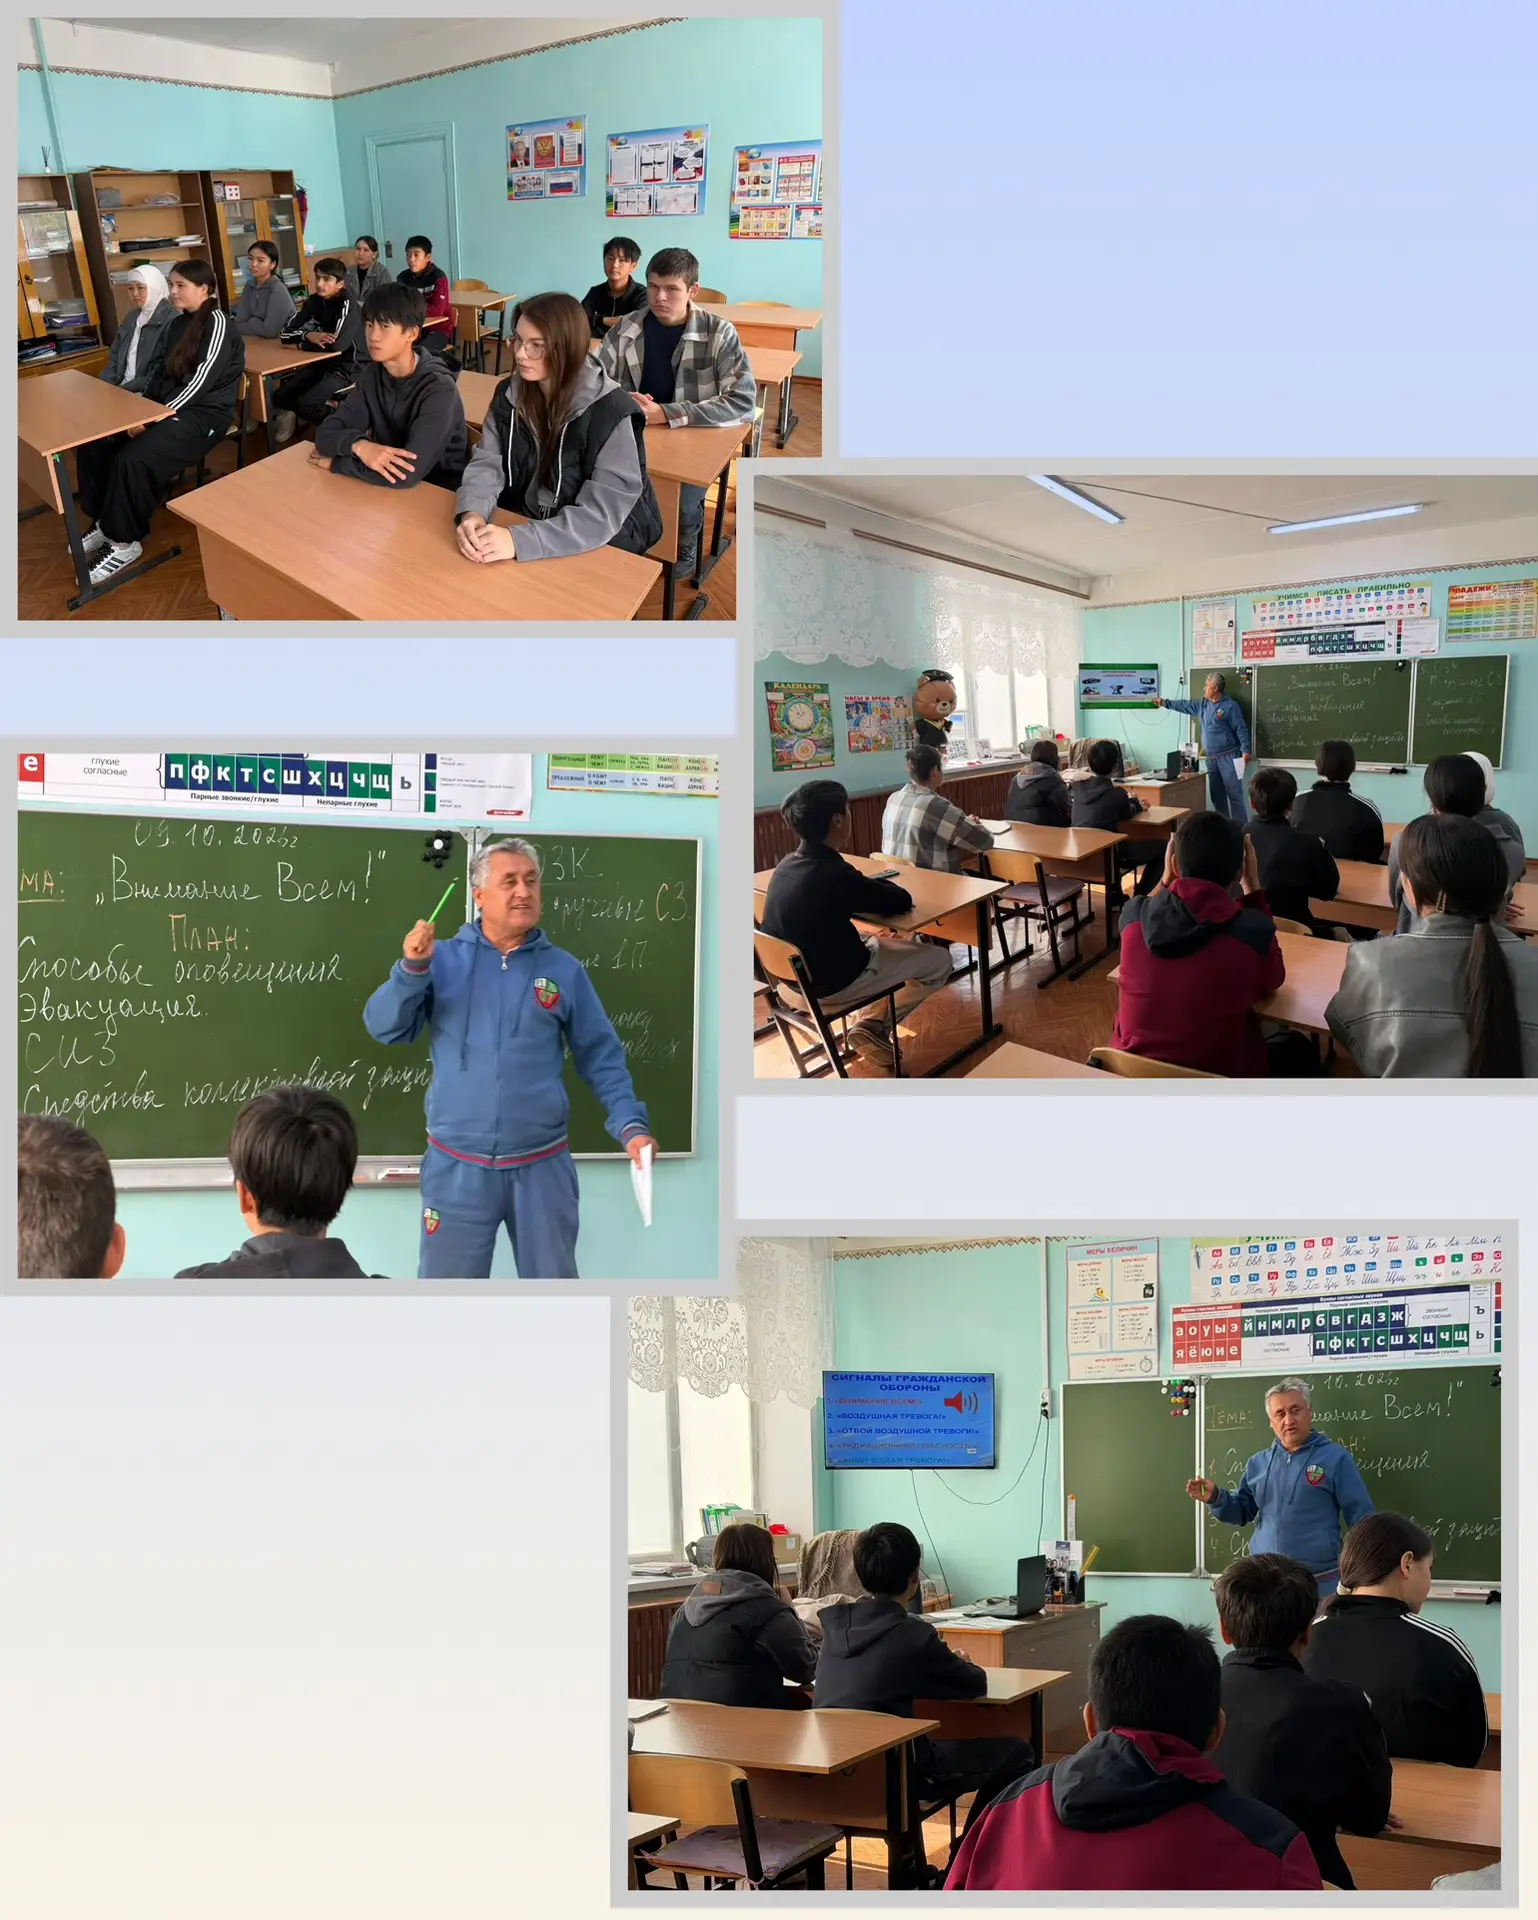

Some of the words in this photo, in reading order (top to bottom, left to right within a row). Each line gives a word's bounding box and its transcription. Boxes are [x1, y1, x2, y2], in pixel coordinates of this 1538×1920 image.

[1277, 592, 1309, 600] УЧИМСЯ
[1317, 588, 1350, 597] ПИСАТЬ
[1357, 582, 1411, 593] ПРАВИЛЬНО
[1455, 585, 1492, 594] ПАДЕЖИ
[773, 682, 821, 690] КАЛЕНДАРЬ
[24, 756, 38, 772] е
[91, 757, 120, 767] глухие
[83, 767, 128, 777] согласные
[170, 765, 184, 779] п
[191, 760, 210, 785] ф
[217, 766, 231, 782] к
[240, 767, 252, 782] т
[263, 768, 275, 783] с
[283, 769, 301, 784] ш
[308, 770, 322, 785] х
[330, 772, 345, 789] ц
[353, 773, 365, 787] ч
[372, 774, 390, 792] щ
[190, 792, 219, 803] Парные
[221, 793, 279, 804] звонкие/глухие
[317, 798, 352, 808] Непарные
[354, 799, 379, 809] глухие
[25, 1031, 117, 1074] СИЗ
[1107, 1245, 1138, 1254] ВЕЛИЧИН
[1244, 1319, 1252, 1332] й
[1258, 1320, 1266, 1330] н
[1272, 1320, 1282, 1330] м
[1286, 1318, 1296, 1328] л
[1302, 1317, 1310, 1330] р
[1316, 1314, 1326, 1326] б
[1332, 1316, 1340, 1326] в
[1347, 1314, 1355, 1324] г
[1361, 1314, 1372, 1326] д
[1377, 1312, 1386, 1322] з
[1391, 1310, 1404, 1321] ж
[1176, 1326, 1184, 1336] а
[1188, 1326, 1197, 1335] о
[1202, 1325, 1210, 1337] у
[1215, 1324, 1226, 1334] ы
[1230, 1323, 1238, 1332] э
[1316, 1339, 1324, 1350] п
[1330, 1336, 1341, 1352] ф
[1346, 1337, 1355, 1347] к
[1362, 1336, 1370, 1346] т
[1376, 1335, 1385, 1346] с
[1391, 1334, 1404, 1344] ш
[1408, 1333, 1418, 1343] х
[1423, 1332, 1434, 1344] ц
[1440, 1331, 1450, 1342] ч
[1454, 1330, 1468, 1342] щ
[1176, 1348, 1184, 1358] я
[1188, 1346, 1197, 1357] ё
[1201, 1347, 1212, 1356] ю
[1216, 1346, 1224, 1356] и
[1230, 1346, 1238, 1356] е
[831, 1373, 892, 1382] СИГНАЛЫ
[895, 1375, 986, 1384] ГРАЖДАНСКОЙ
[879, 1384, 941, 1392] ОБОРОНЫ
[875, 1427, 932, 1435] ВОЗДУШНОЙ
